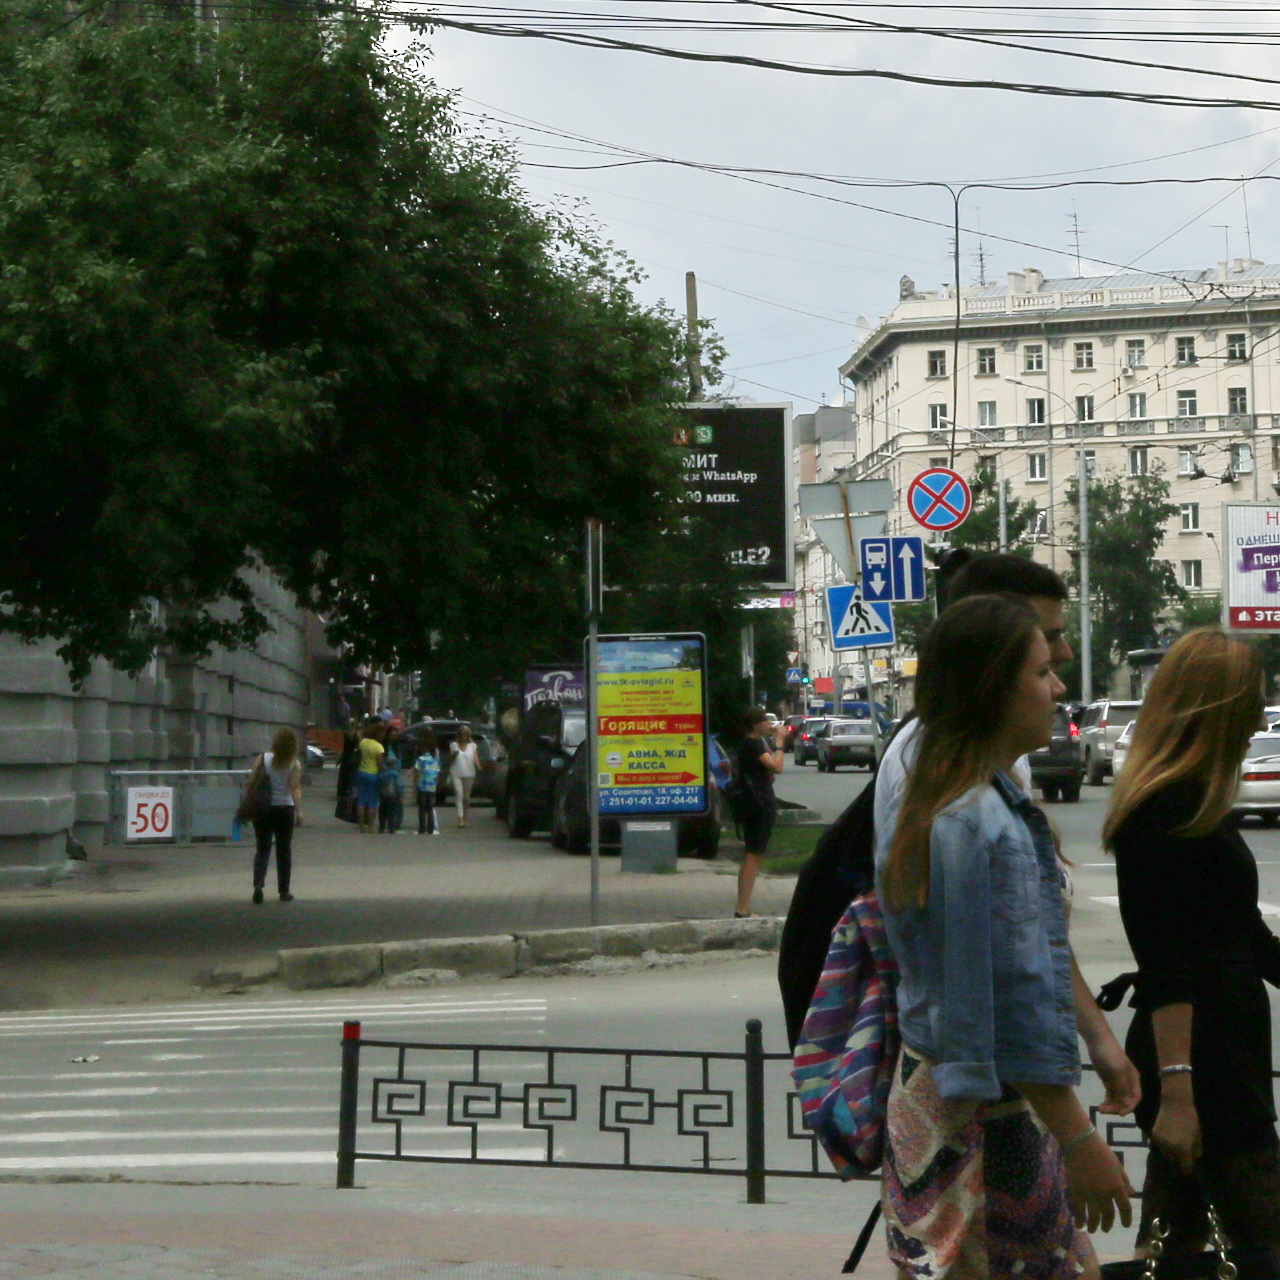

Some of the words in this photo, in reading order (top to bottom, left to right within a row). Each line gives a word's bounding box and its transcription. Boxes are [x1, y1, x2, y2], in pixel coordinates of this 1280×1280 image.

[703, 471, 758, 483] WhatsApp
[706, 493, 740, 503] мин.
[724, 546, 770, 565] ELE2
[600, 717, 668, 734] Горящие
[628, 749, 662, 759] АВИА,
[664, 749, 687, 759] Ж/Д
[628, 761, 666, 770] КАССА
[685, 786, 699, 794] 217
[655, 796, 699, 805] 227-04-04
